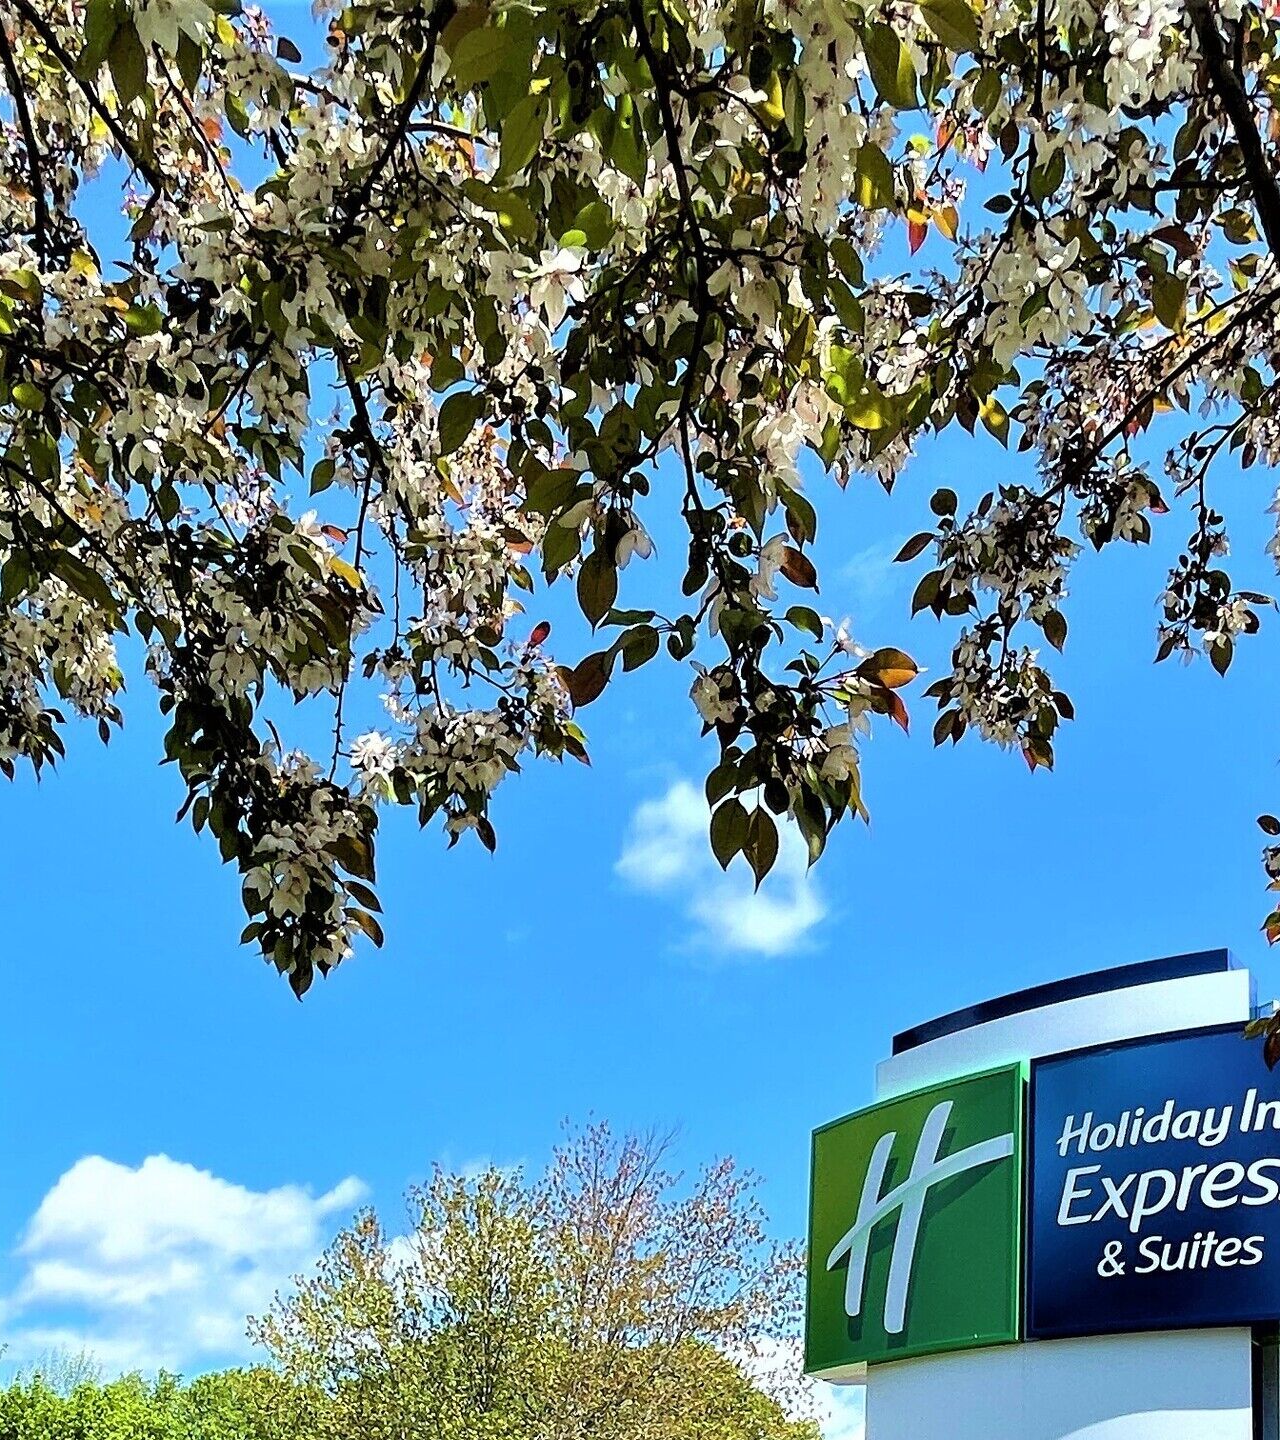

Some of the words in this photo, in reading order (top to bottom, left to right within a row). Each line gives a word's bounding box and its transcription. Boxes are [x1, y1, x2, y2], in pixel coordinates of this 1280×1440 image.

[1056, 1099, 1233, 1157] Holiday
[1097, 1240, 1126, 1278] &
[1134, 1230, 1265, 1274] Suites
